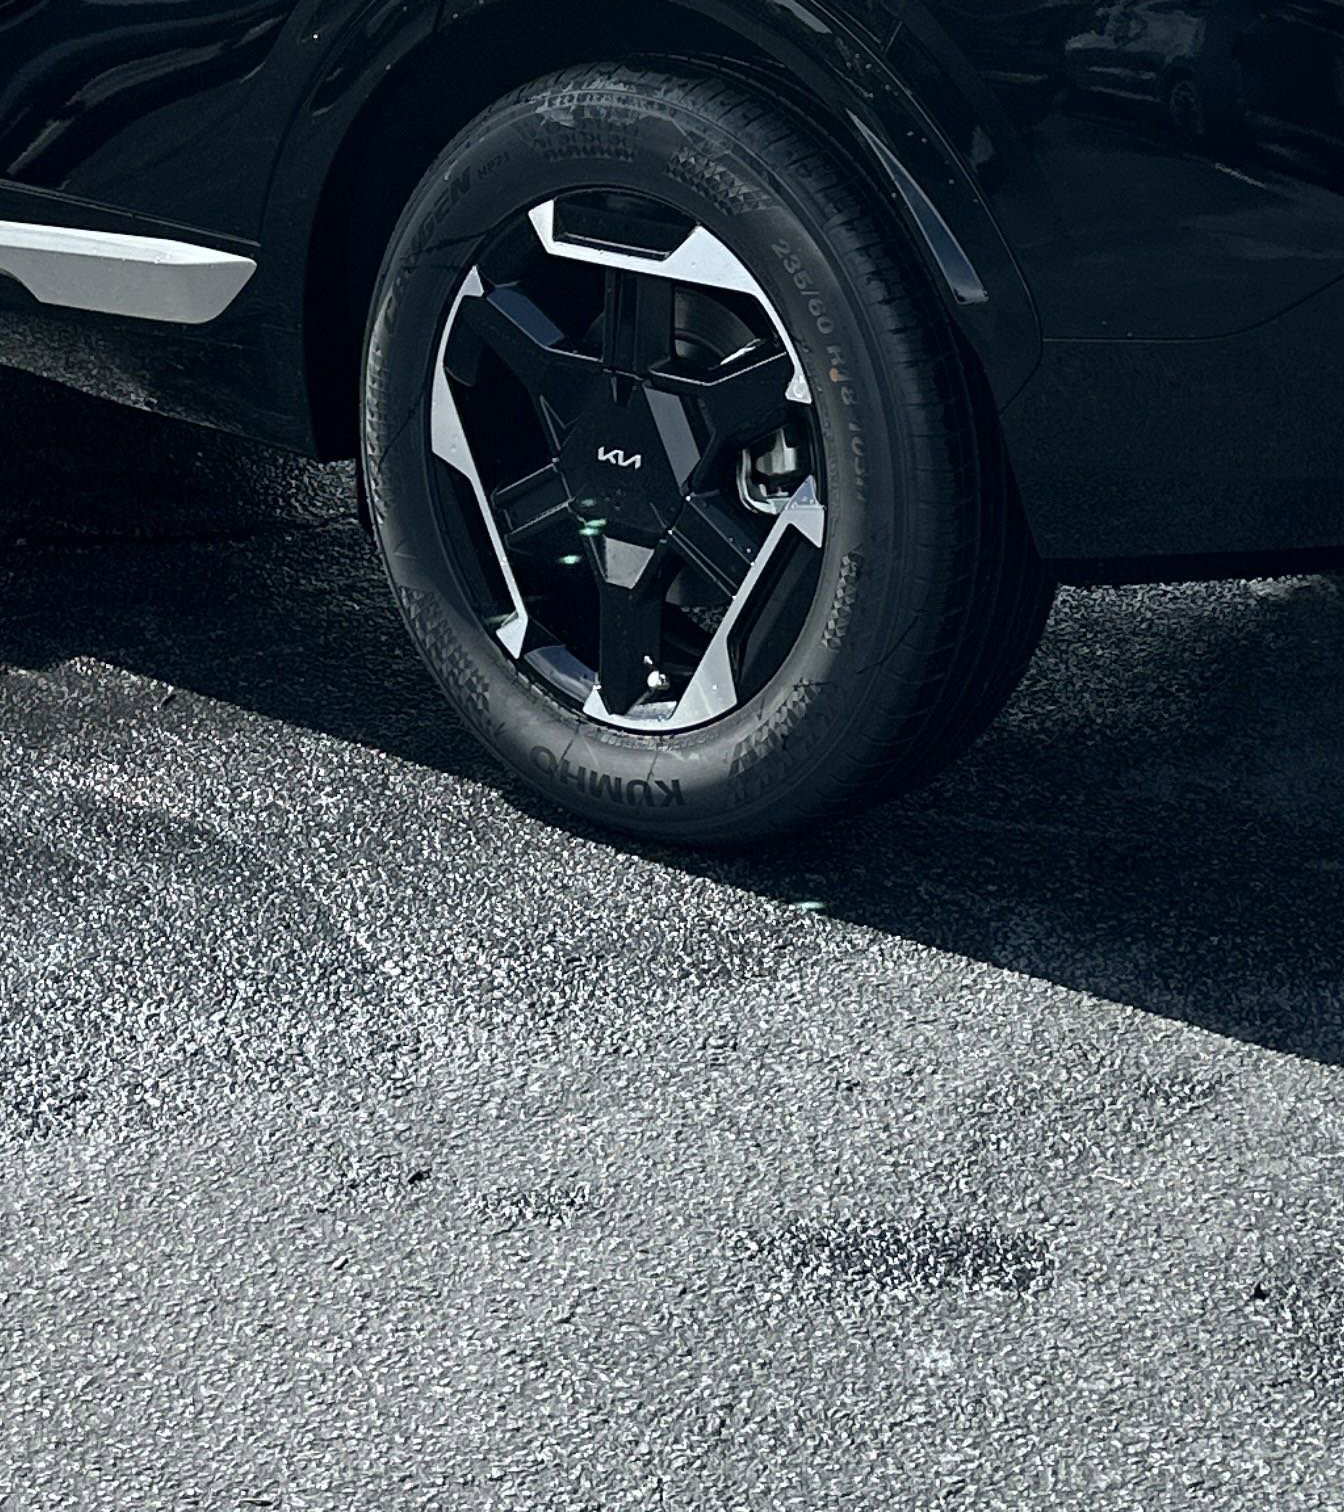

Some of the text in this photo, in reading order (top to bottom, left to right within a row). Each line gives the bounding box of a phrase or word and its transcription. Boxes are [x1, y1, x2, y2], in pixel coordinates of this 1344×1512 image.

[475, 148, 510, 181] HP71
[768, 231, 837, 338] 235/60
[597, 446, 642, 470] KIA
[524, 739, 687, 810] KUMHO
